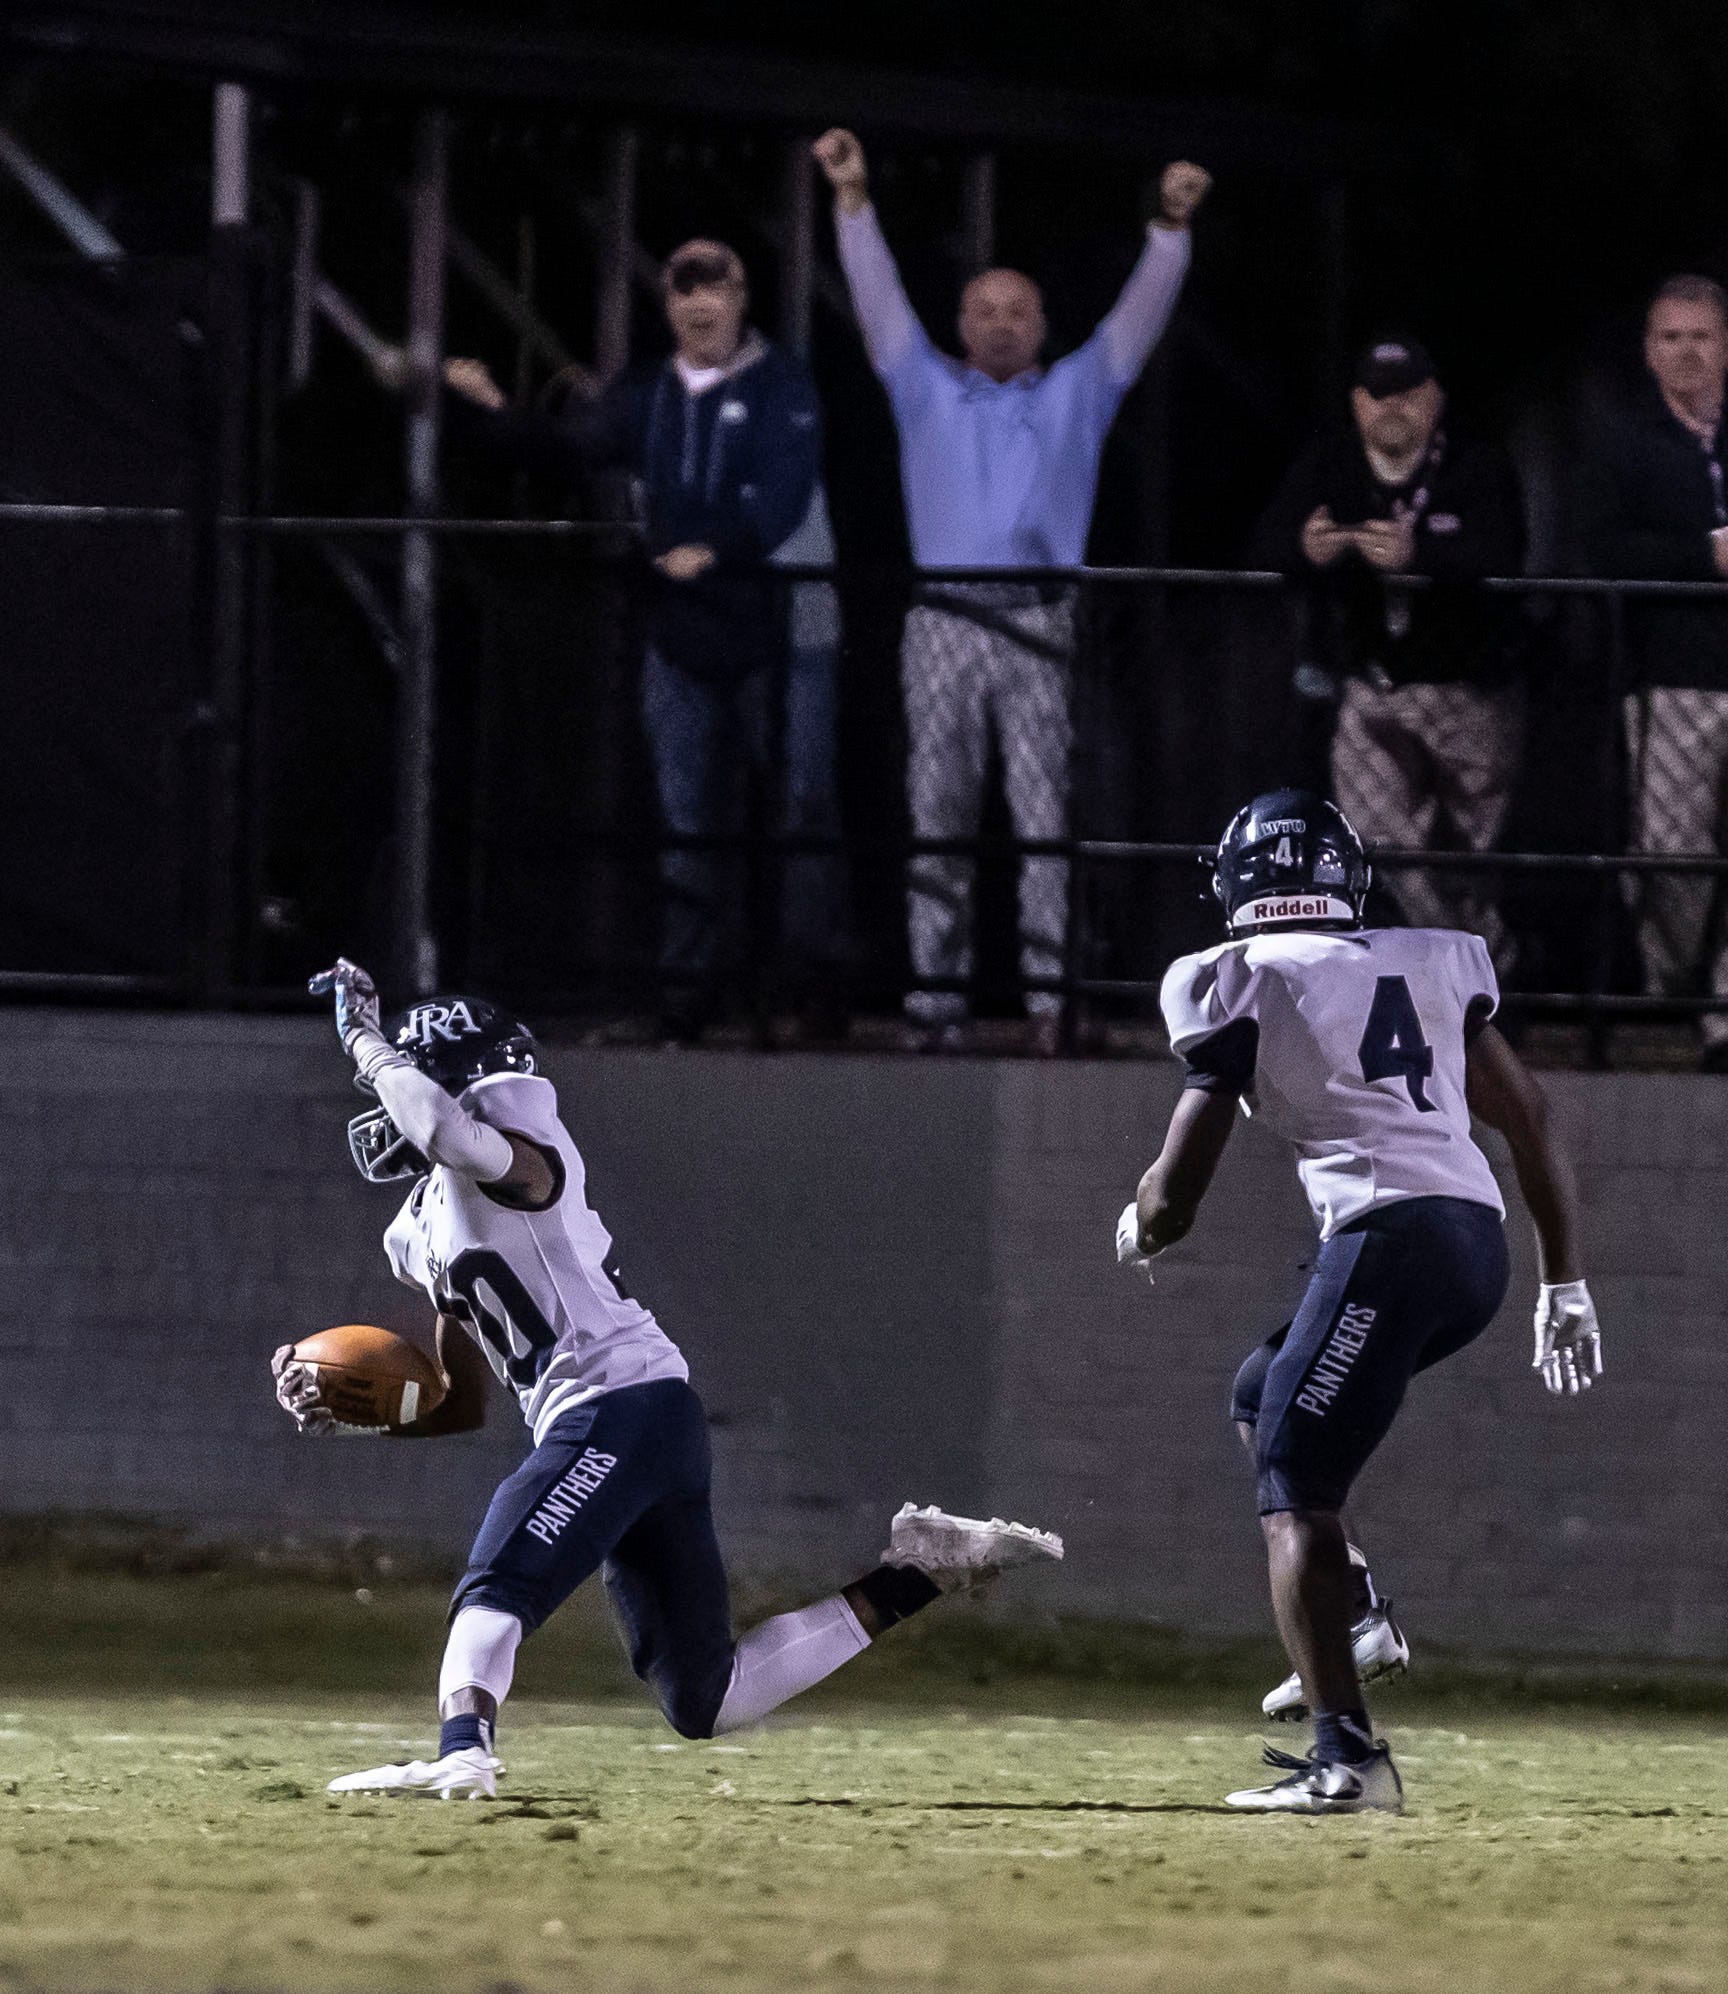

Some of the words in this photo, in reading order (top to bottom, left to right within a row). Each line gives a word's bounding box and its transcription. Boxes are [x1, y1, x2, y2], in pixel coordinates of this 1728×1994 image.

[1275, 836, 1294, 867] 4
[1253, 899, 1329, 920] Riddell
[405, 1000, 482, 1046] FRA
[1358, 975, 1438, 1112] 4
[1295, 1302, 1377, 1417] PANTHERS
[526, 1445, 618, 1545] PANTHERS
